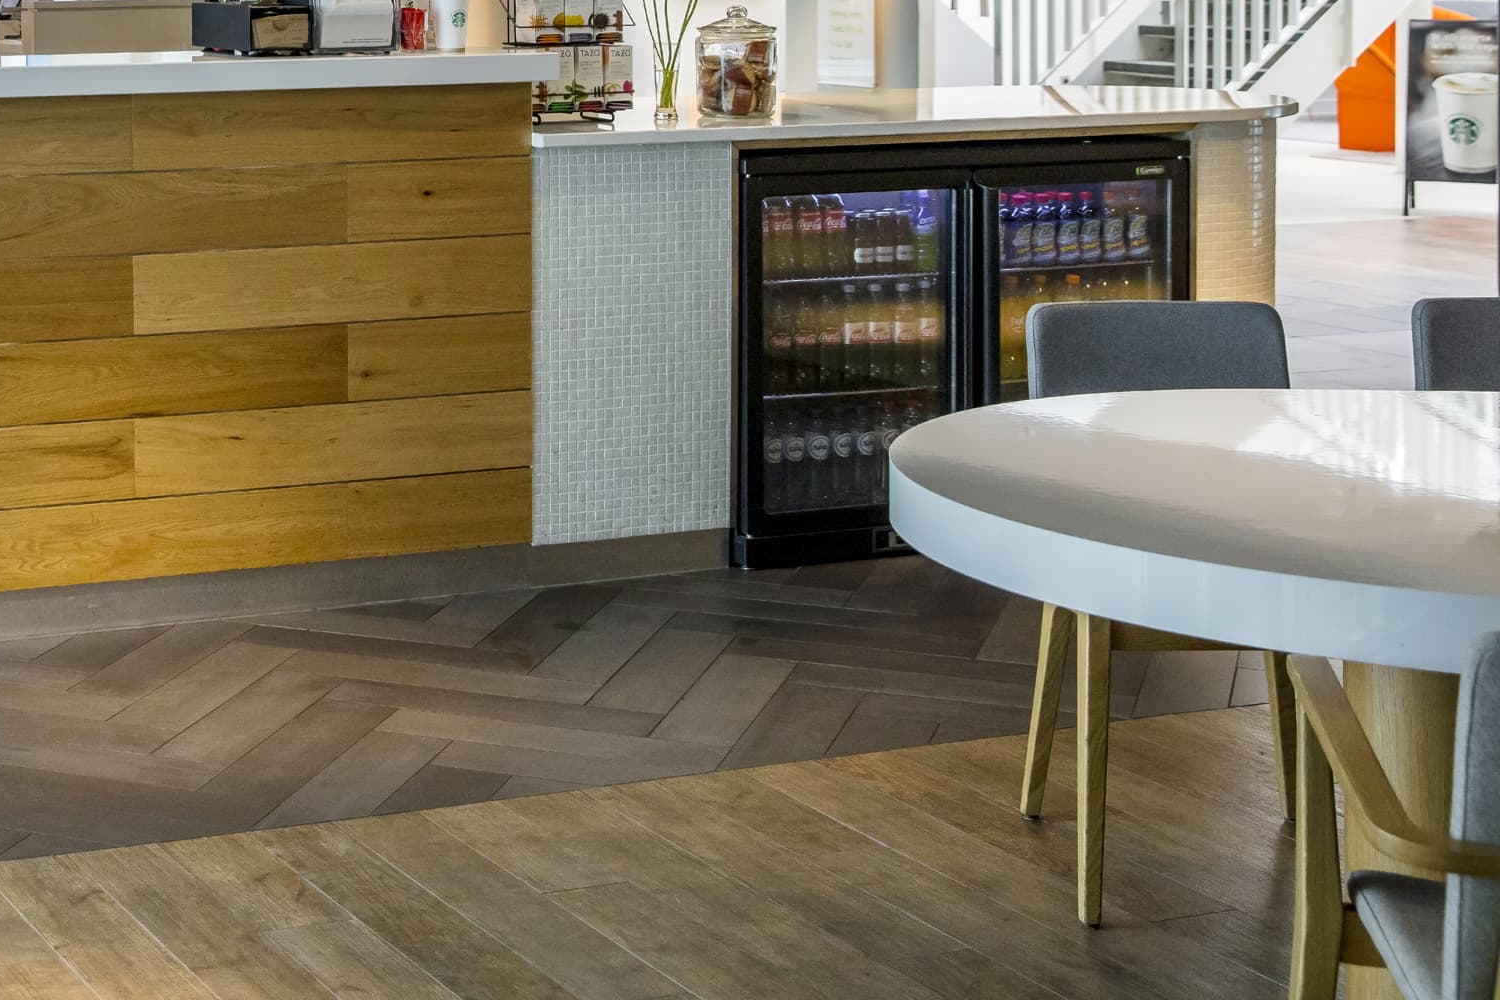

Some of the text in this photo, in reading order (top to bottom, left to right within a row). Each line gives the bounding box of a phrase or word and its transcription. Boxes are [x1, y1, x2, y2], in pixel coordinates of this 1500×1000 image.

[560, 50, 572, 58] ZO
[580, 49, 600, 57] TAZO
[611, 49, 631, 57] TAZO
